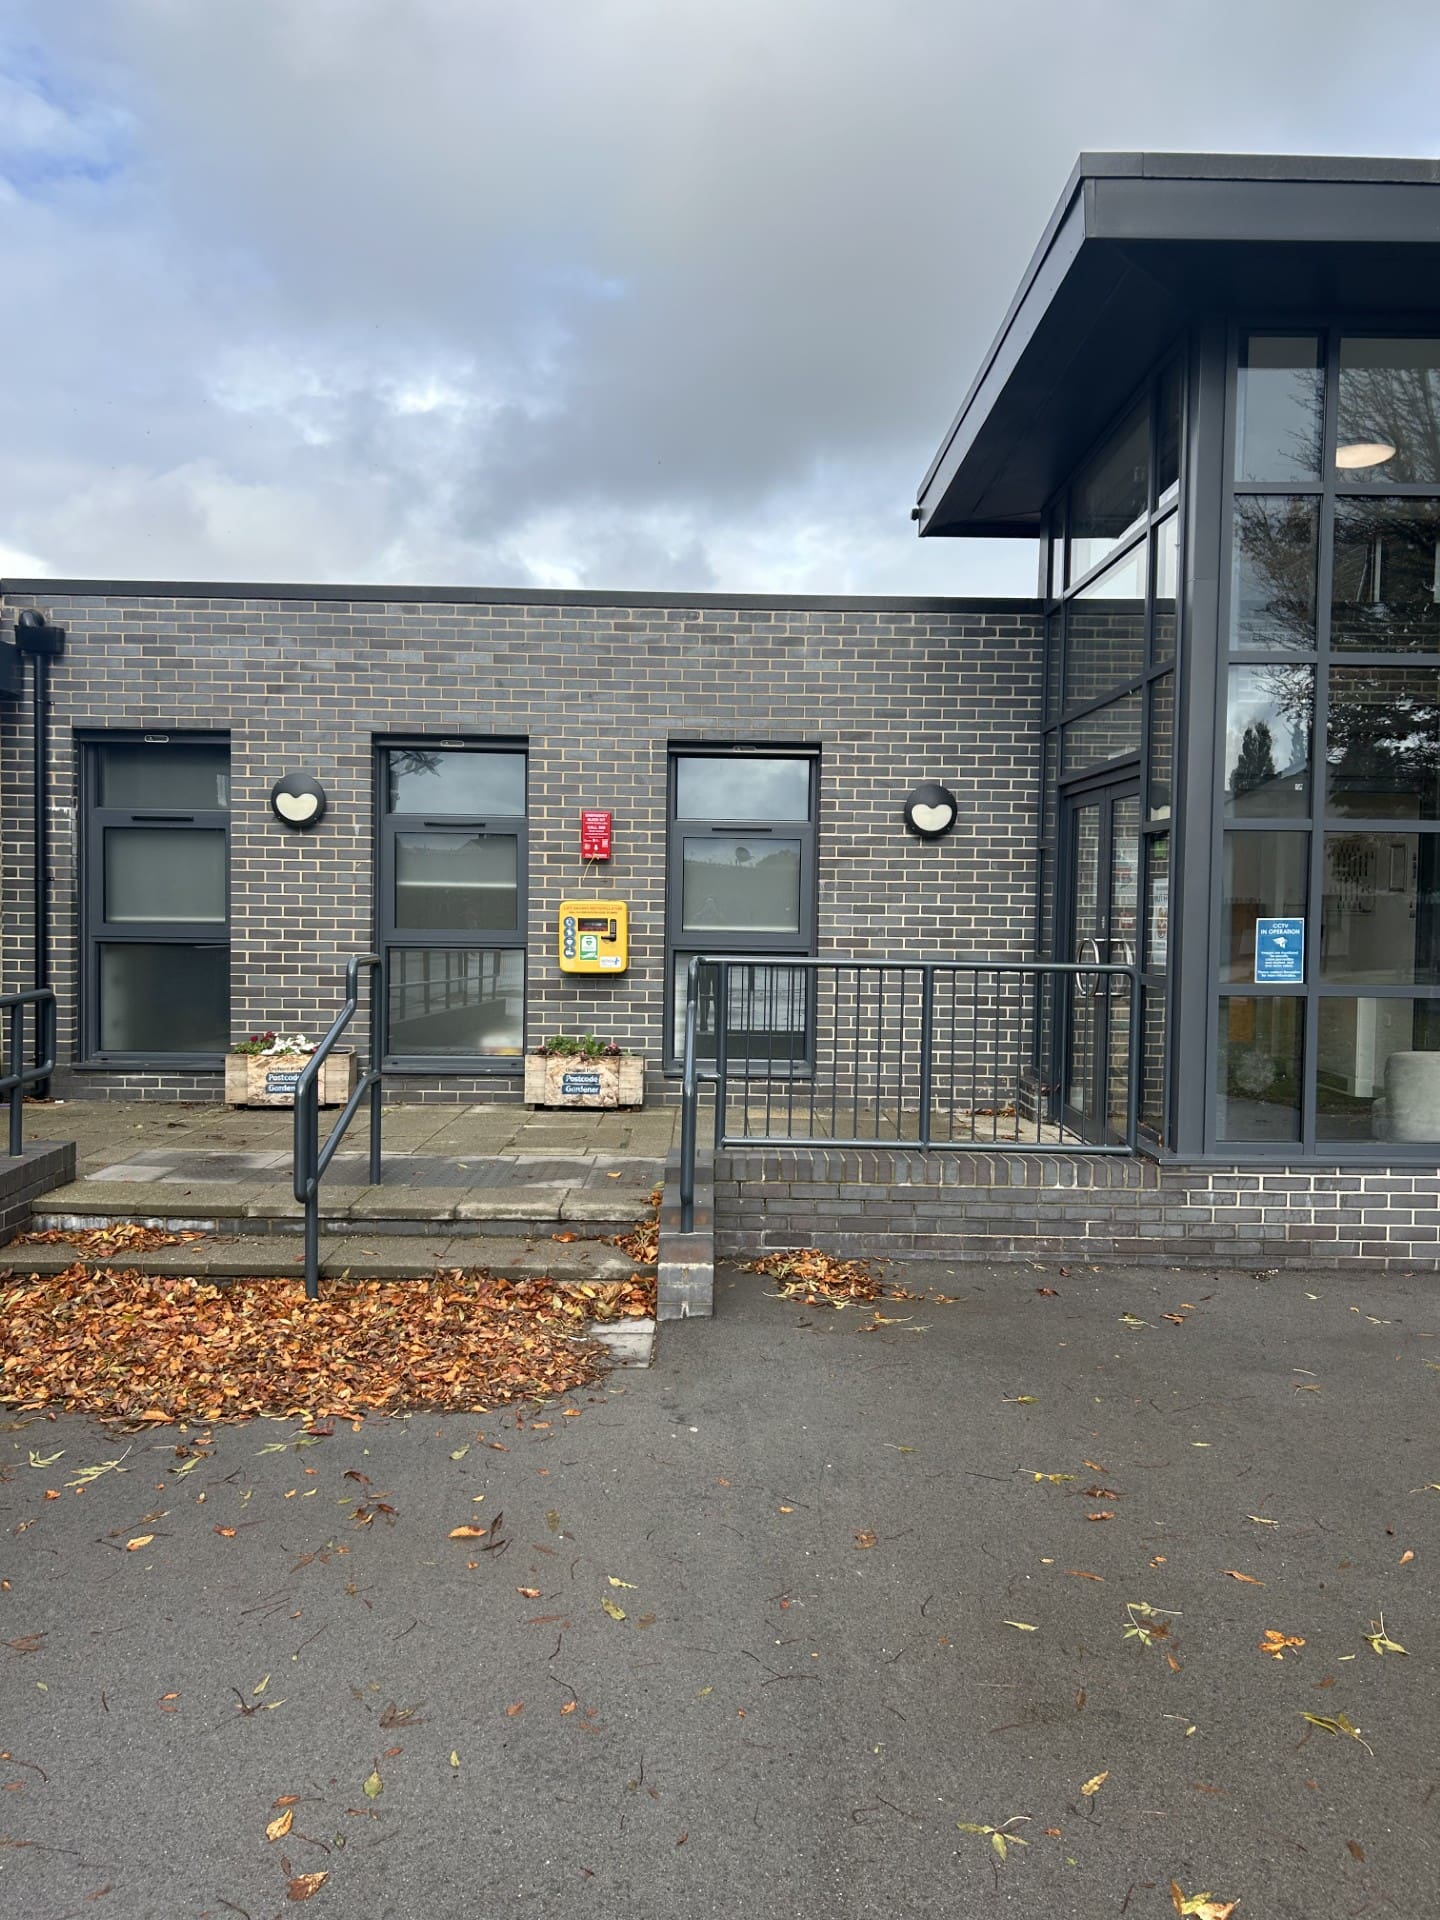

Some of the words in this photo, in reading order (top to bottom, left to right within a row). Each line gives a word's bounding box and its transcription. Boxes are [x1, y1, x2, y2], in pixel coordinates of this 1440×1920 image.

[268, 1073, 300, 1081] Postcod
[565, 1074, 599, 1083] Postcode
[268, 1084, 296, 1092] Garden
[565, 1085, 599, 1093] Gardener
